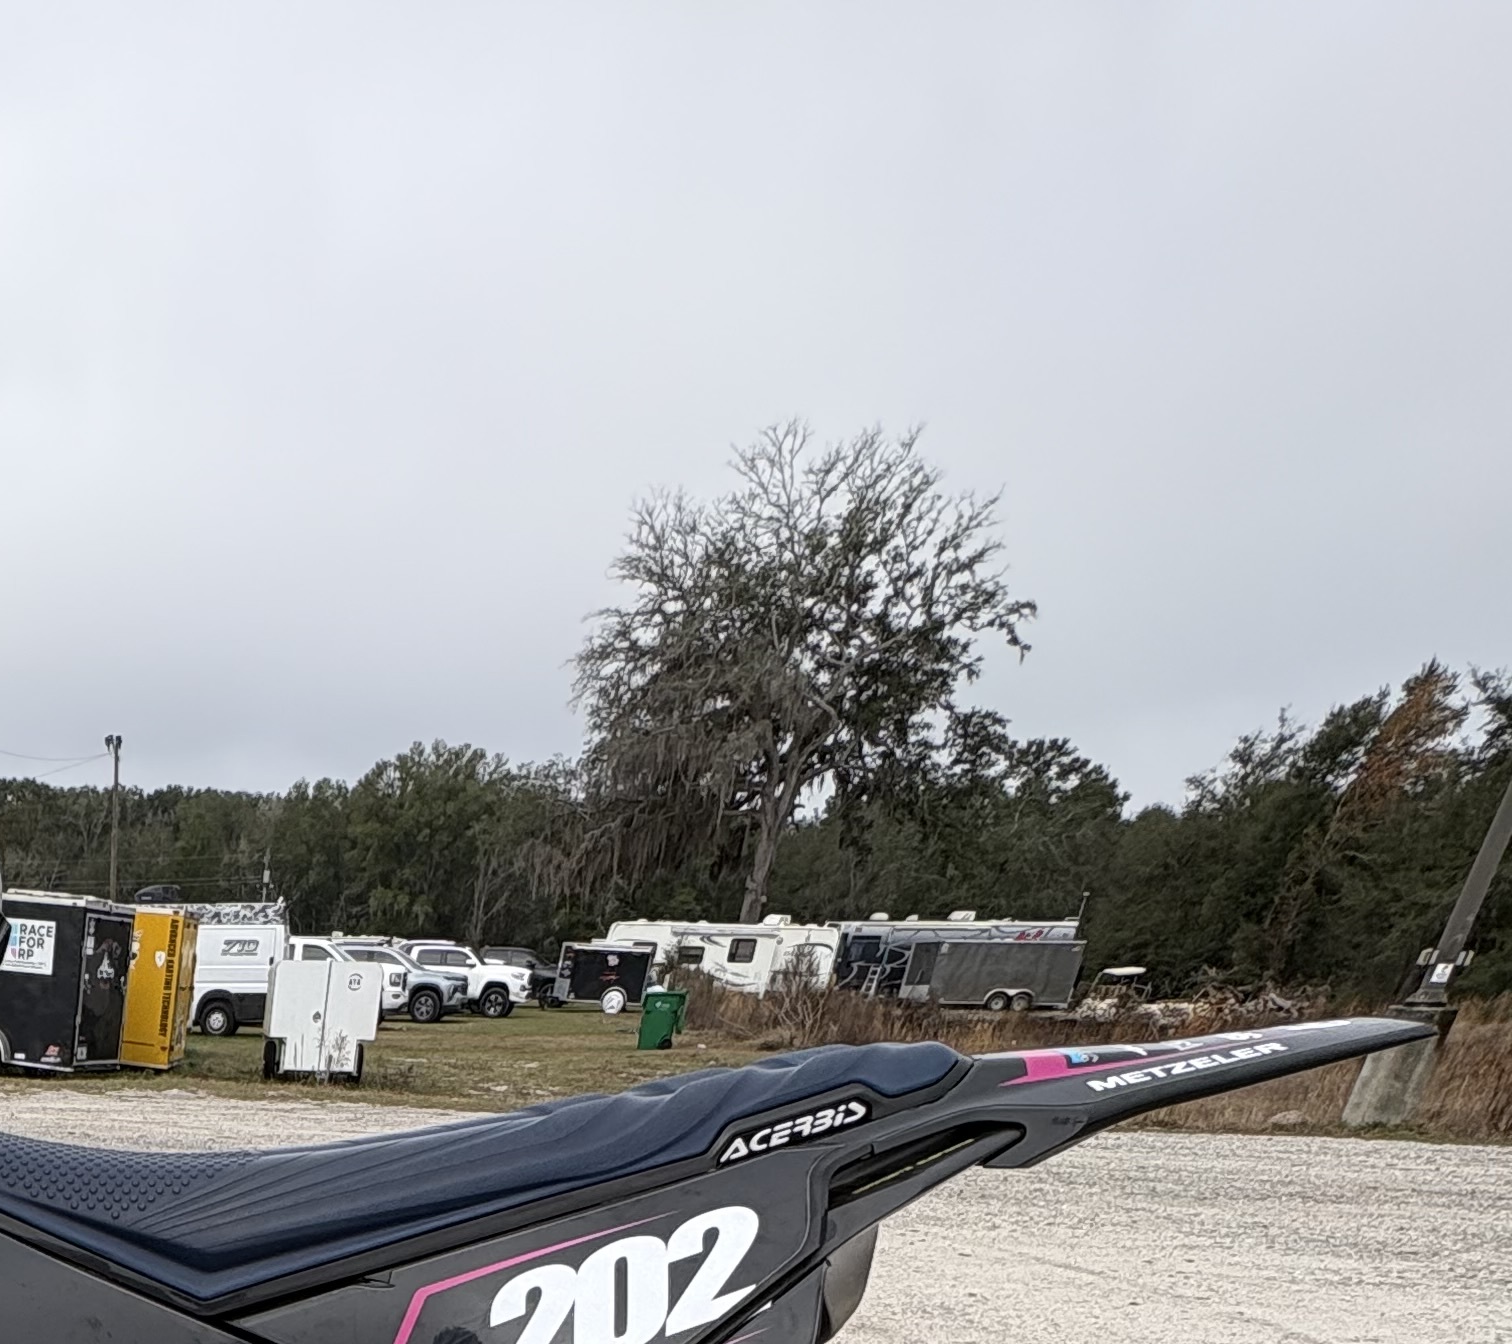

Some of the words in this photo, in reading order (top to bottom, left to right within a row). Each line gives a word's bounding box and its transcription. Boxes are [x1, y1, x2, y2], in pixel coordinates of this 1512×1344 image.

[19, 924, 54, 938] RACE
[18, 936, 45, 949] FOR
[18, 948, 34, 960] RP
[1085, 1041, 1290, 1092] METZELER
[718, 1100, 867, 1163] ACERBIS
